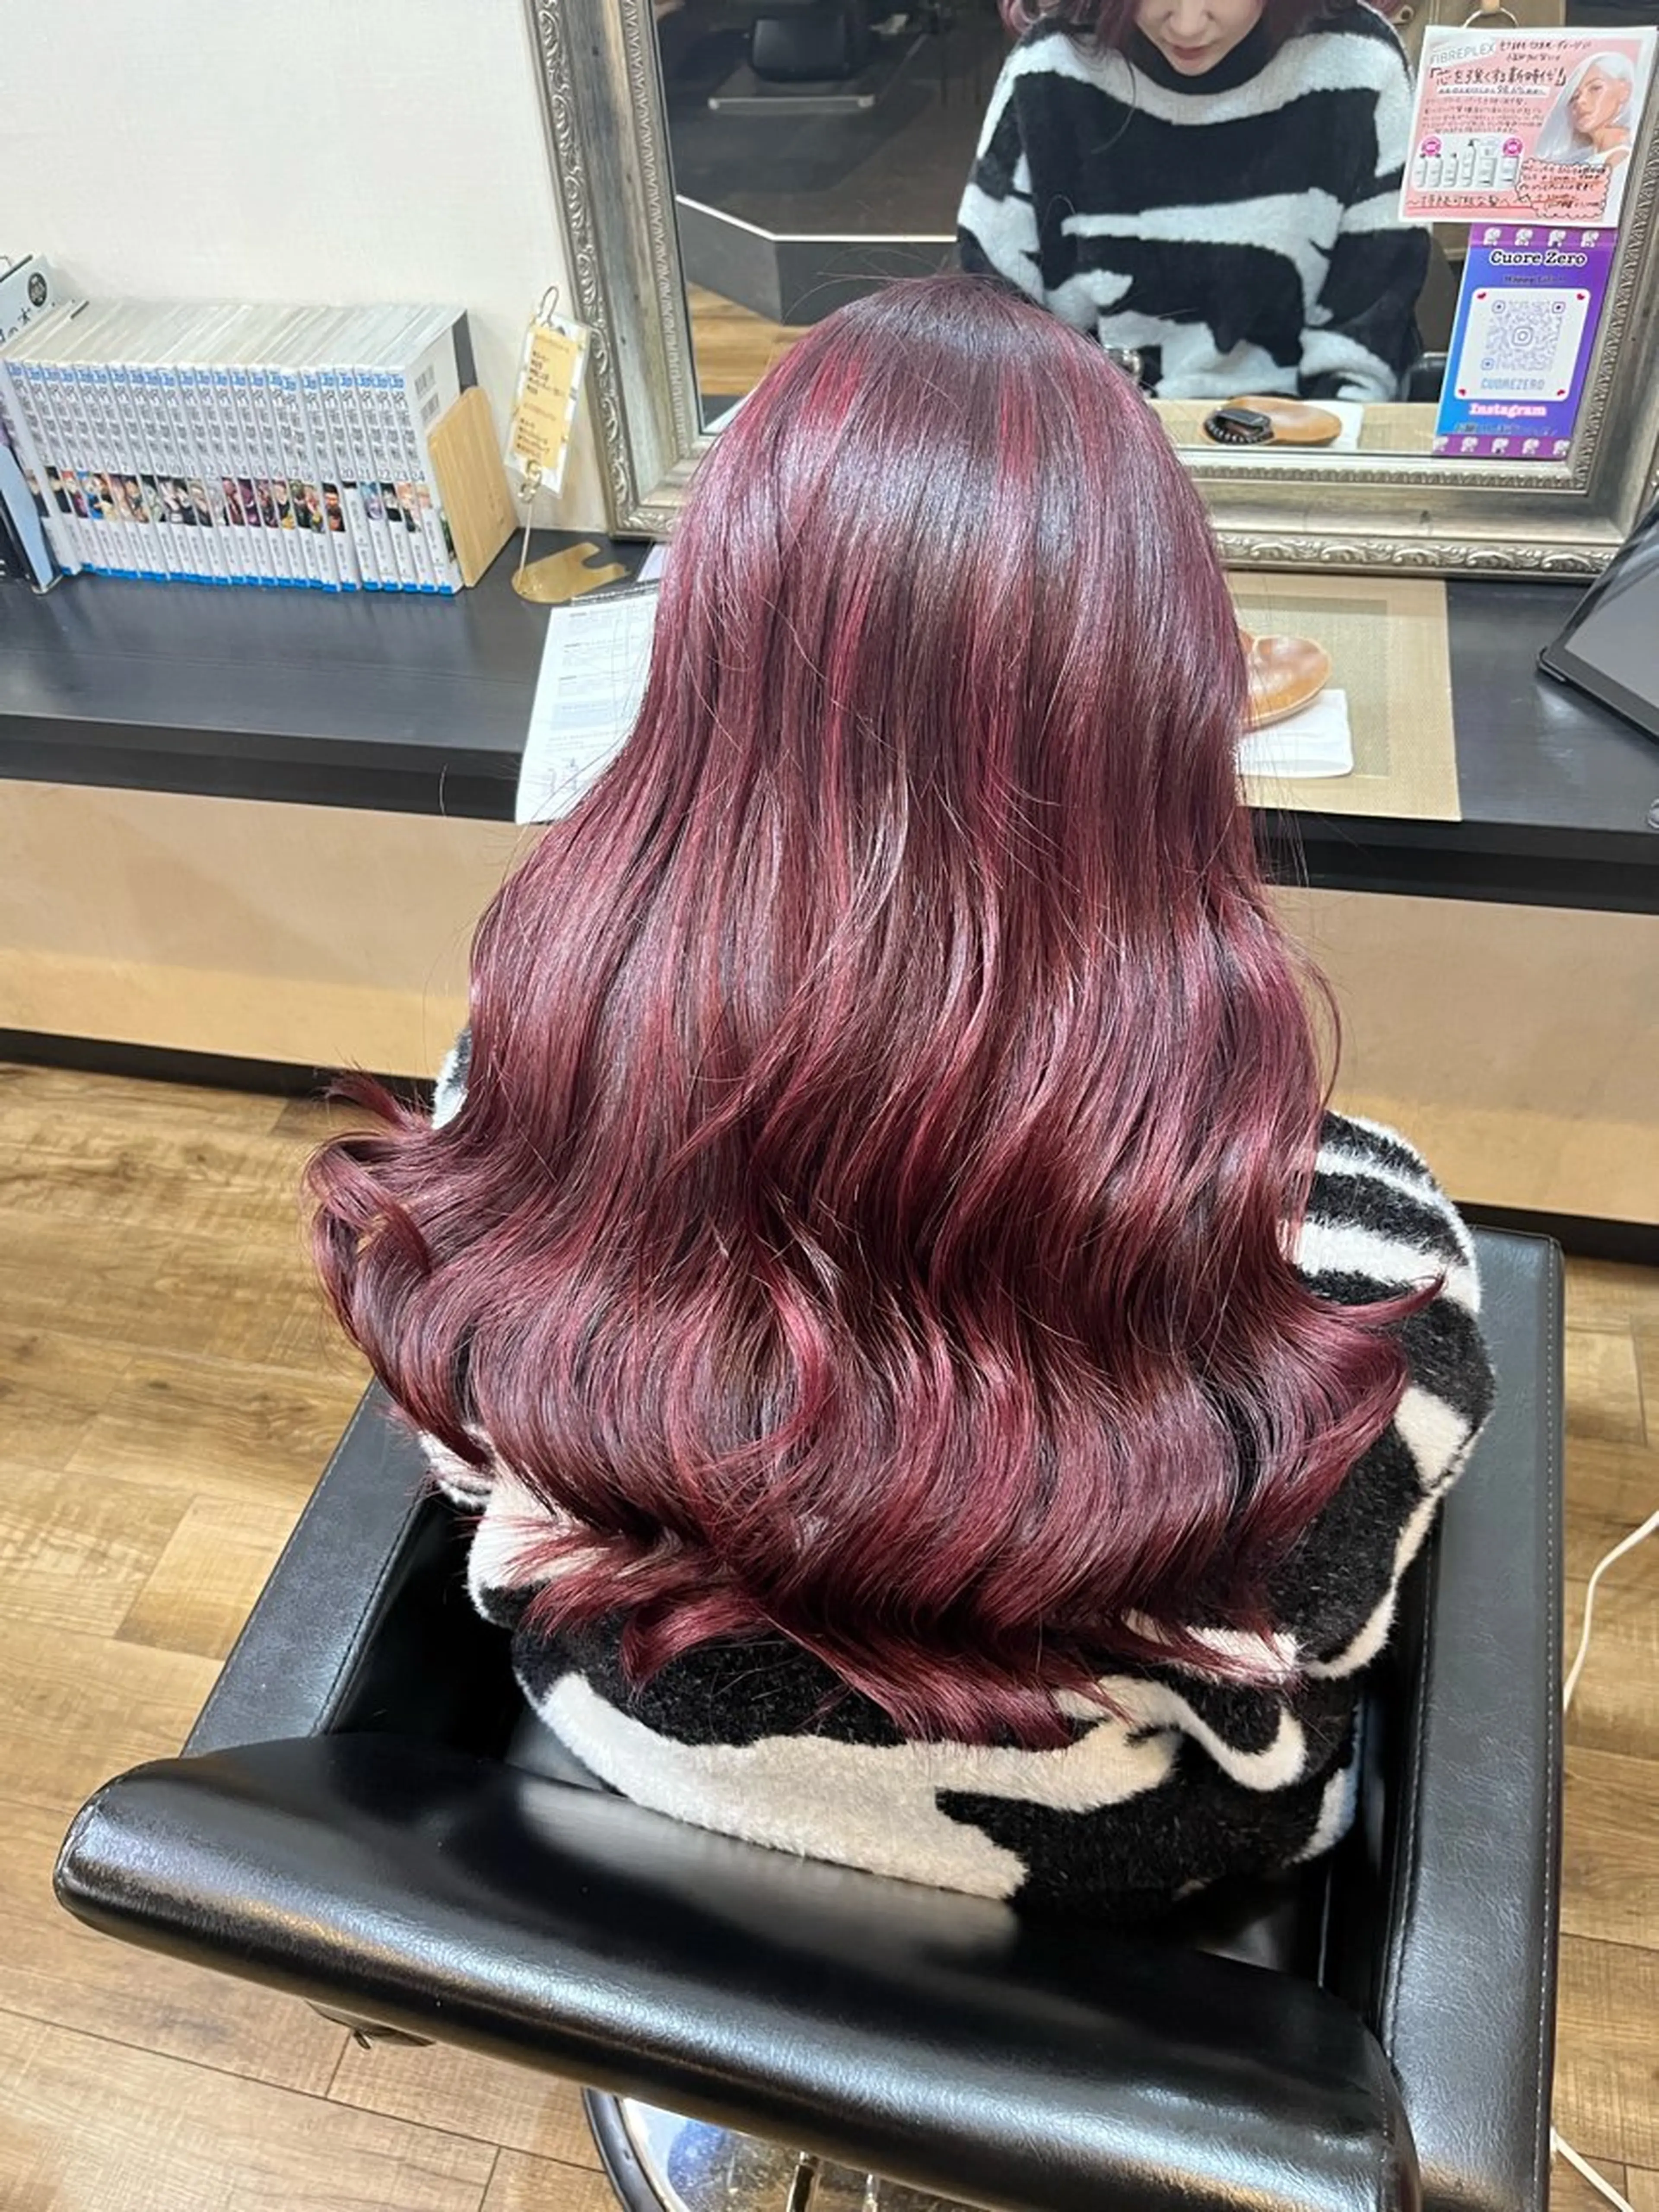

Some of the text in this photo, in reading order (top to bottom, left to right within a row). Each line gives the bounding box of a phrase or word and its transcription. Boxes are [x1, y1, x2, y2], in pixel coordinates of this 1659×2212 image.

[1430, 42, 1496, 64] FIBREPLEX
[1490, 250, 1587, 265] Cuore Zero
[1470, 403, 1547, 418] Instagram
